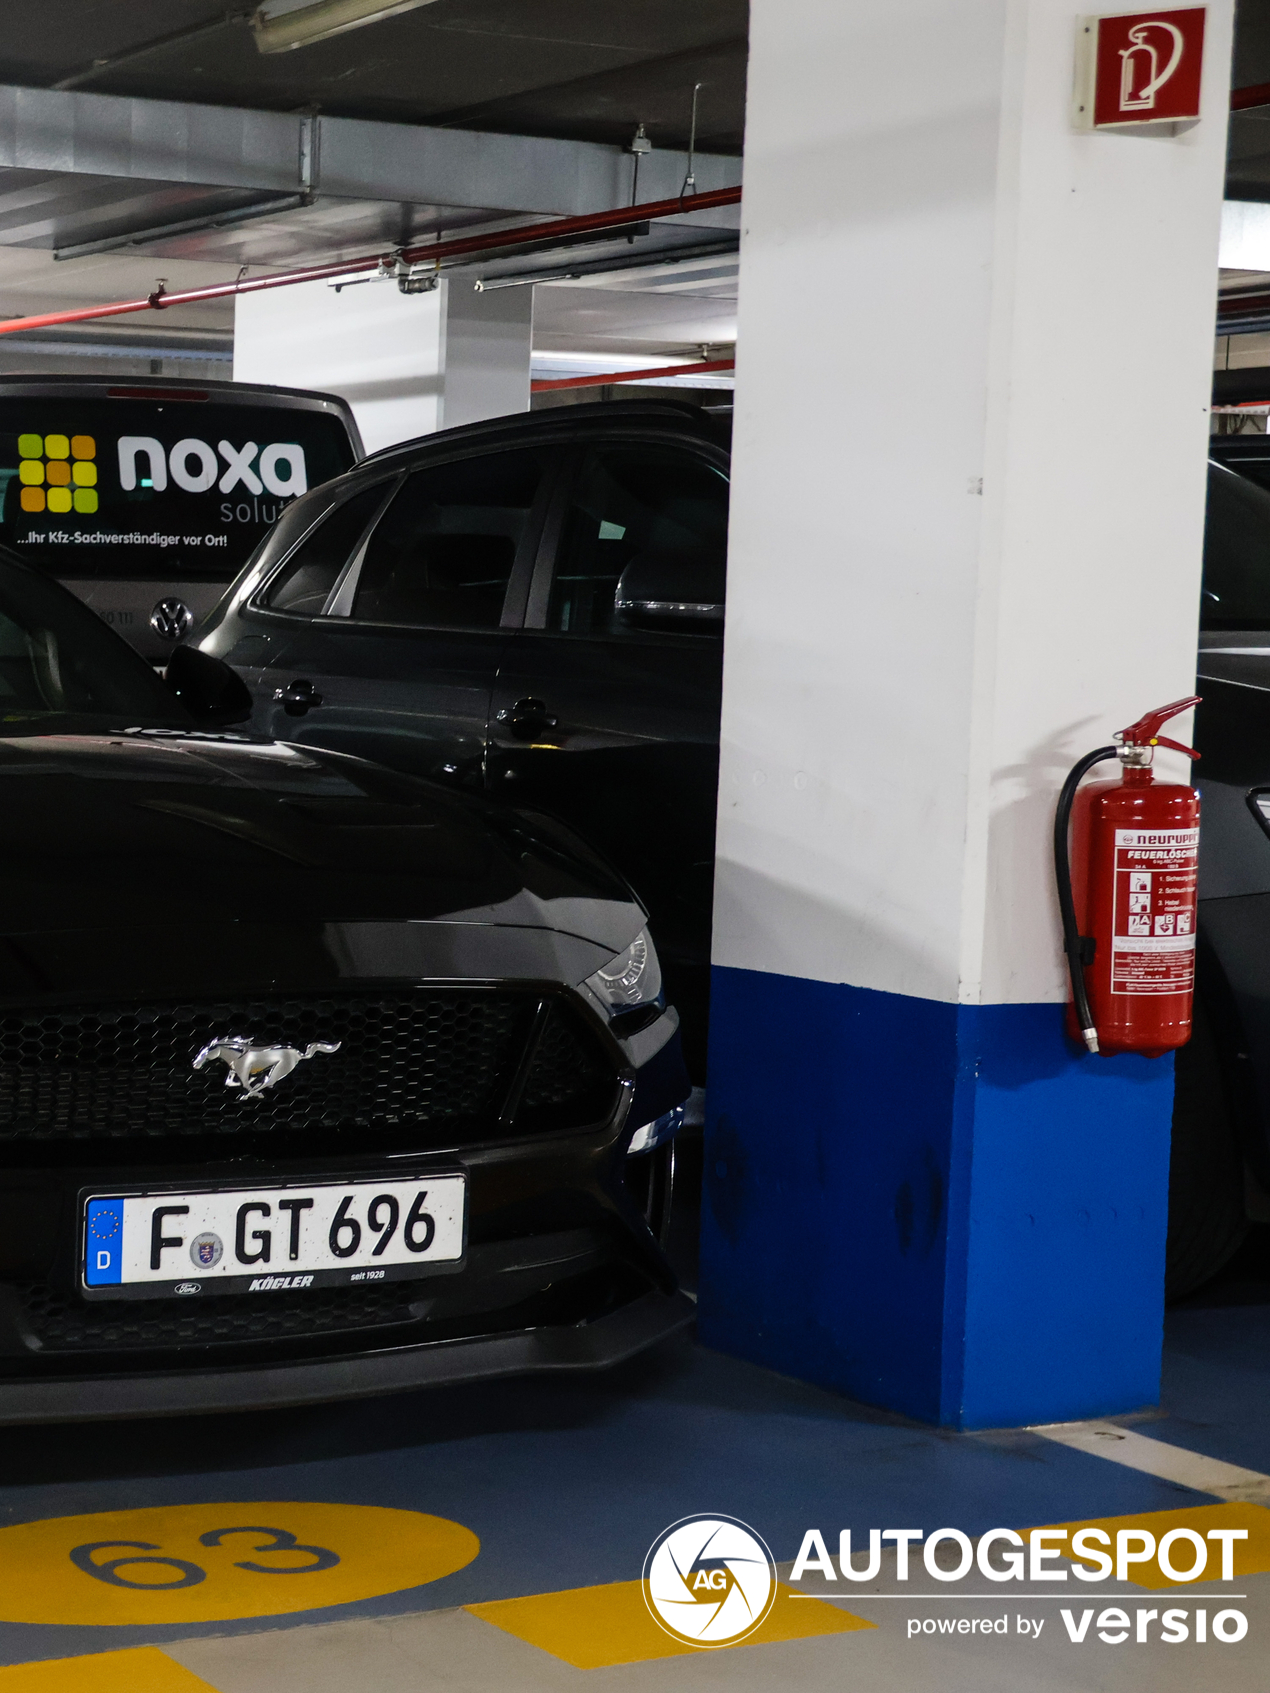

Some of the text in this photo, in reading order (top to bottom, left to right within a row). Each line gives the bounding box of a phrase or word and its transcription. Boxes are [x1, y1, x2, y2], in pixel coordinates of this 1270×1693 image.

[117, 435, 308, 497] noxa
[17, 532, 228, 547] ...Ihr Kfz-Sachverständiger vor Ort!
[150, 1205, 190, 1270] F
[235, 1198, 314, 1264] GT
[329, 1191, 435, 1257] 696
[96, 1250, 111, 1270] D
[249, 1275, 313, 1291] KÖGLER
[350, 1272, 365, 1281] seit
[366, 1270, 385, 1280] 1928
[69, 1526, 340, 1590] 63
